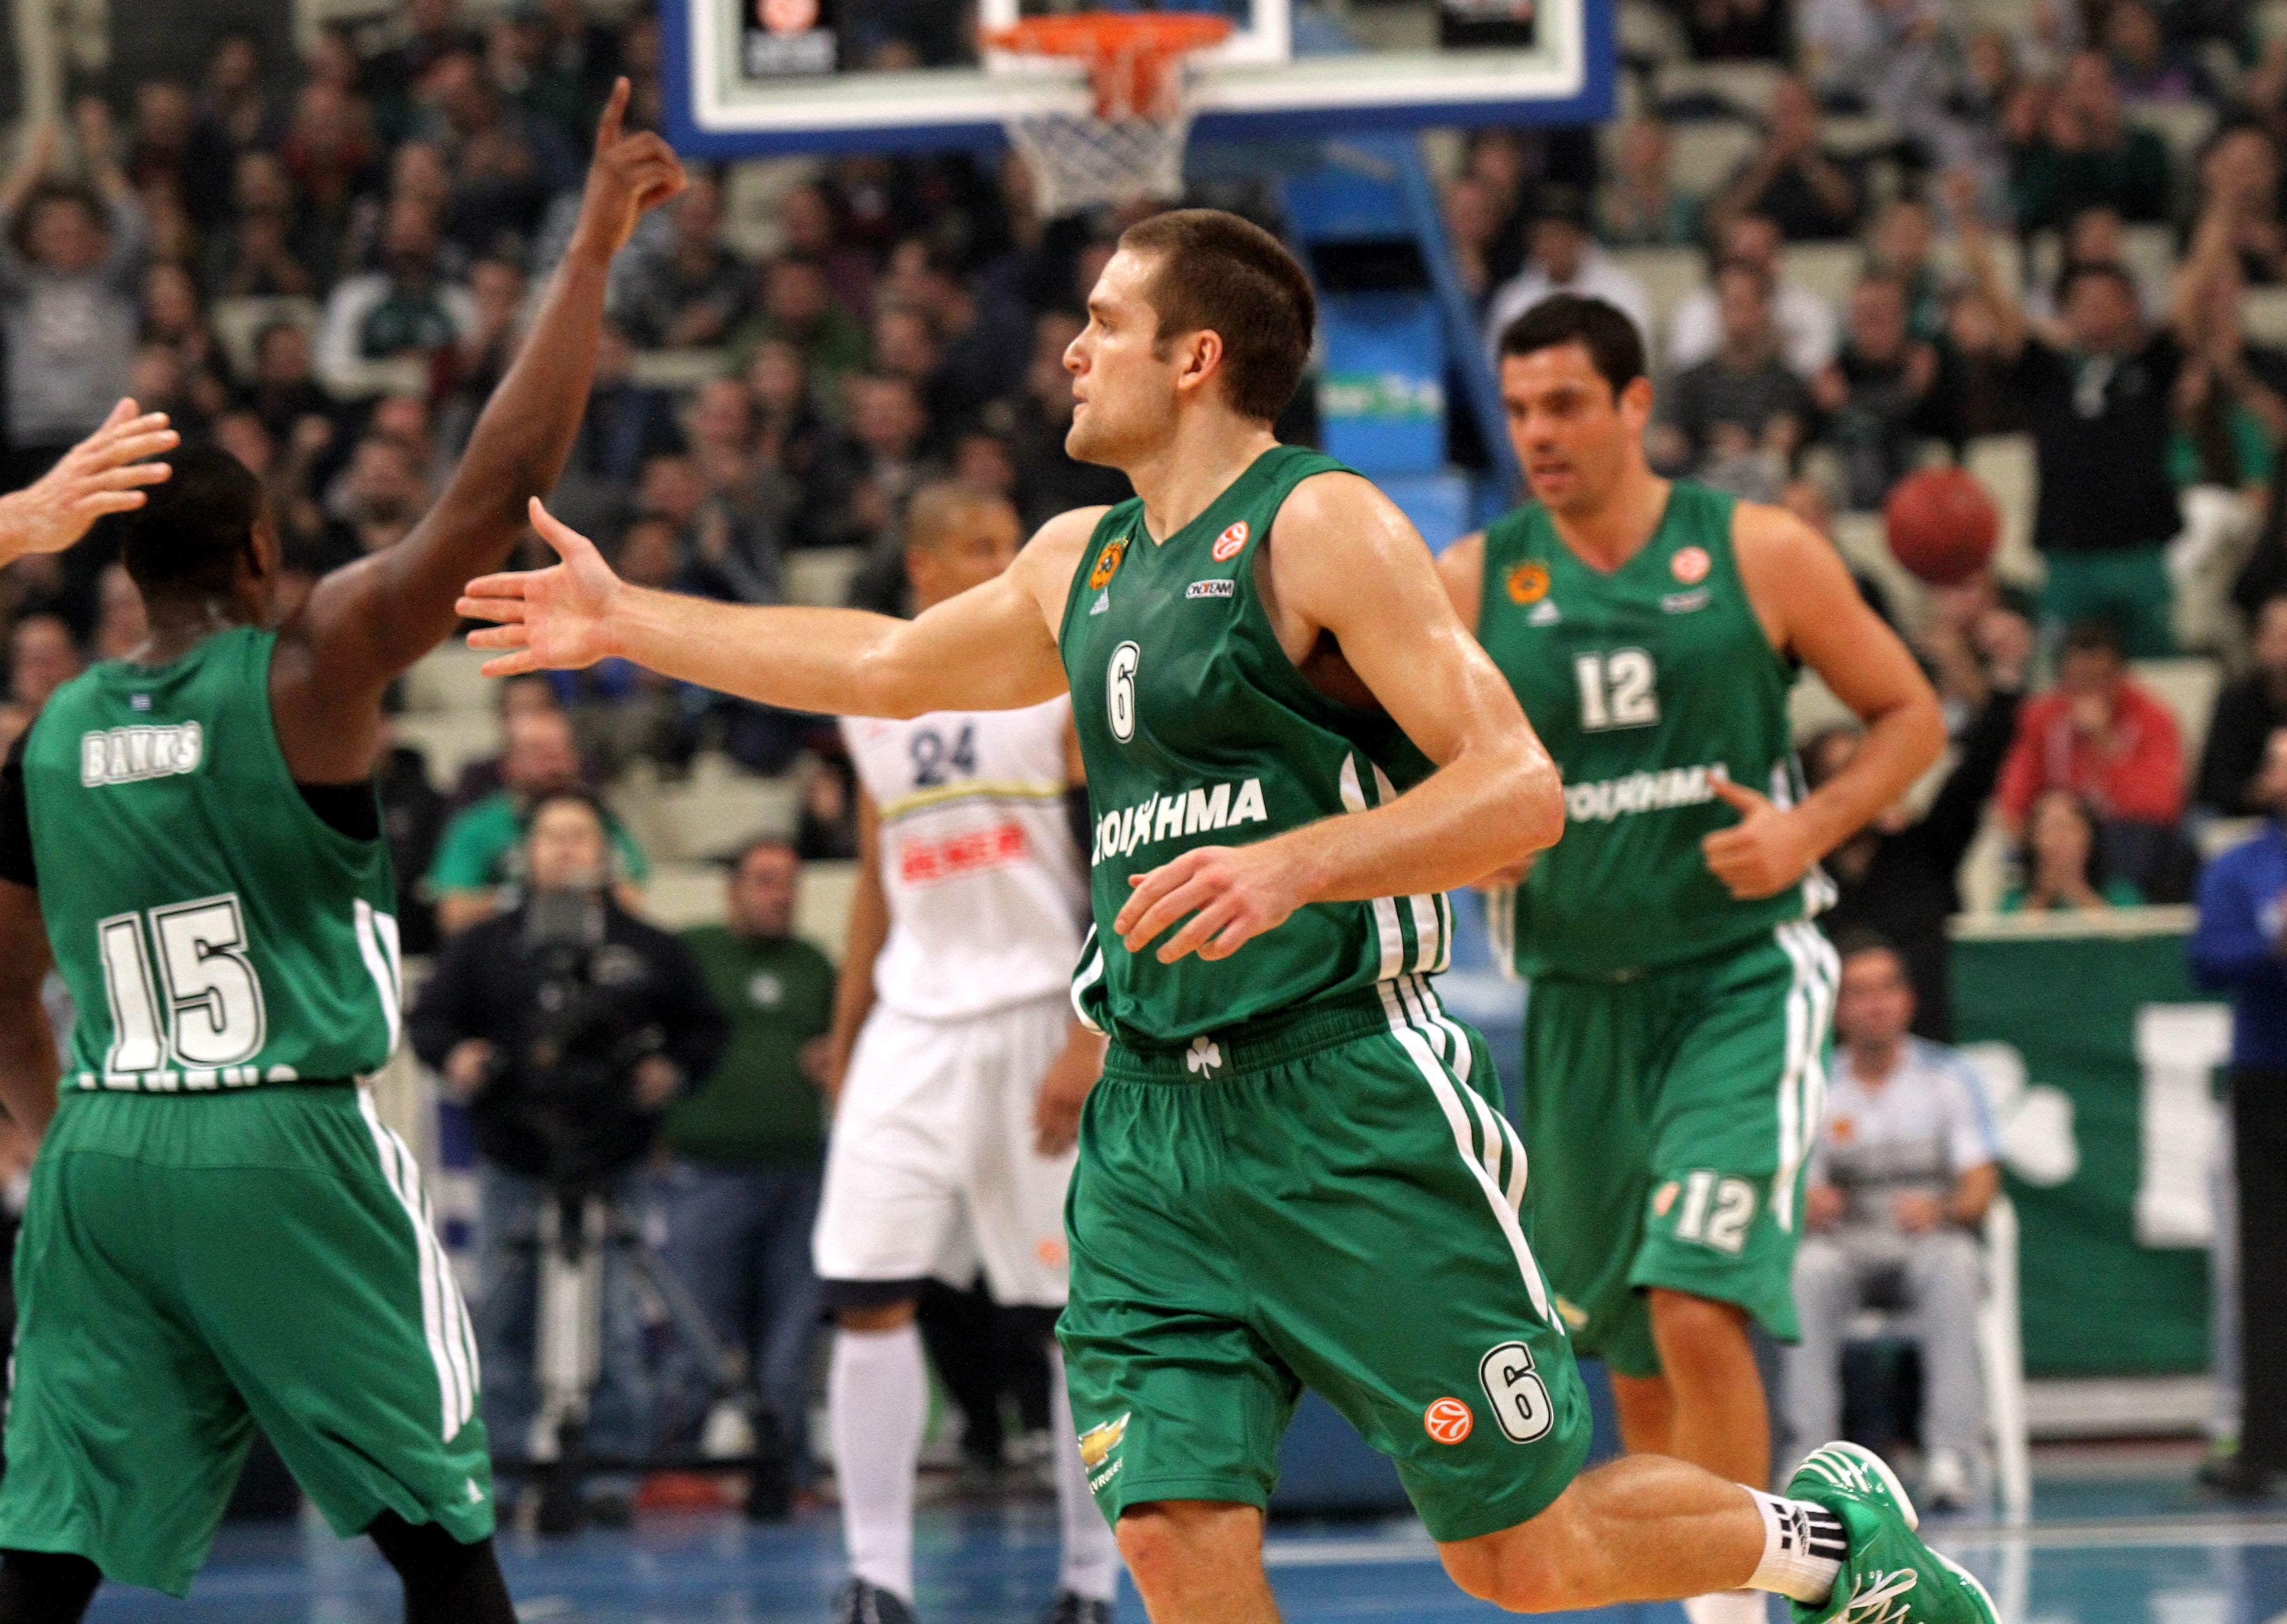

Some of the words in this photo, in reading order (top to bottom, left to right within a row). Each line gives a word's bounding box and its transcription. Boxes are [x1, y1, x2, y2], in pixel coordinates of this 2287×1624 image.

[1106, 640, 1140, 743] 6
[1574, 647, 1662, 733] 12
[81, 720, 203, 787] BANKS
[909, 724, 976, 787] 24
[97, 892, 267, 1075] 15
[1674, 1168, 1757, 1259] 12
[1479, 1341, 1554, 1443] 6
